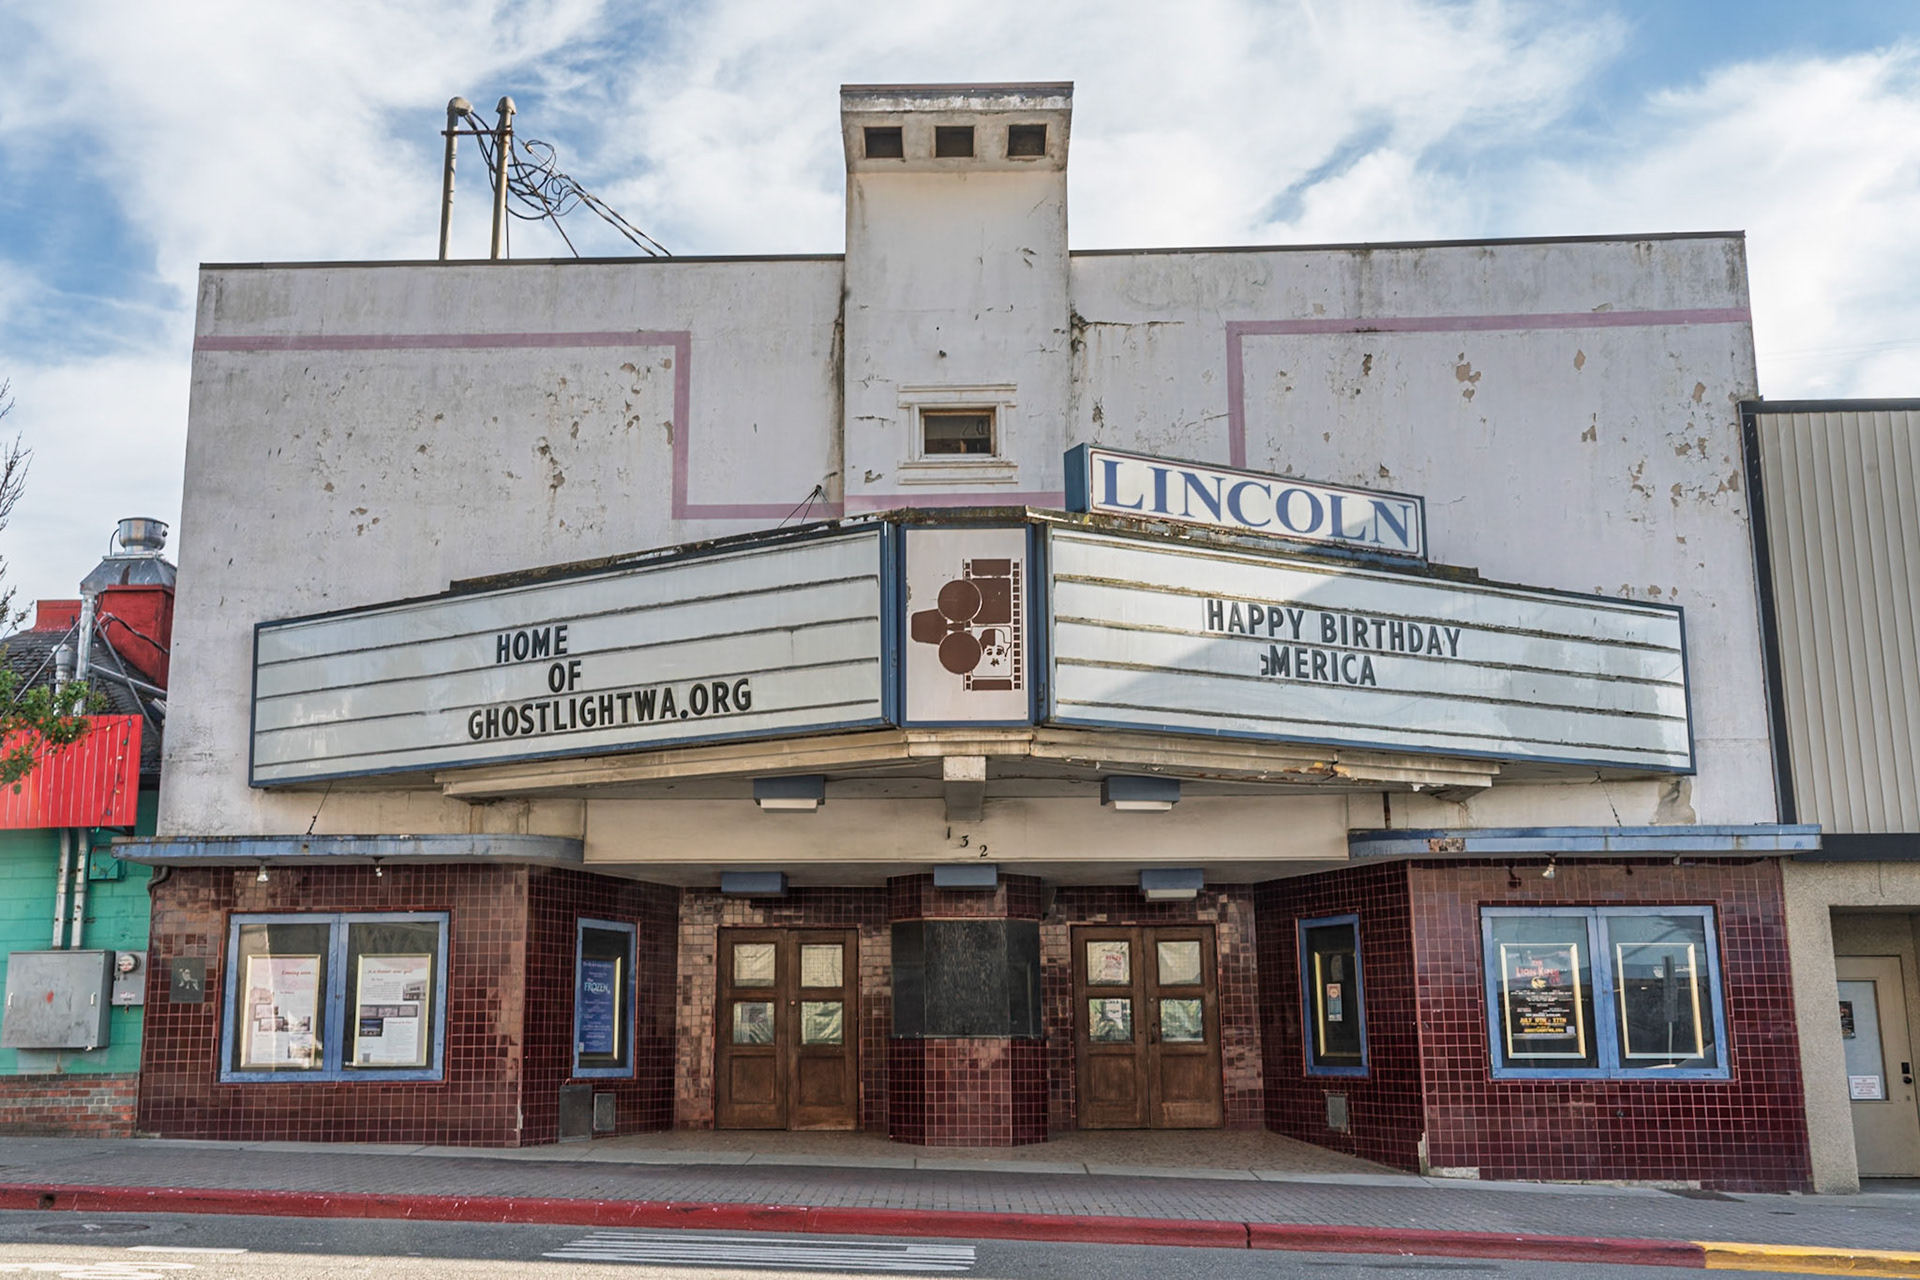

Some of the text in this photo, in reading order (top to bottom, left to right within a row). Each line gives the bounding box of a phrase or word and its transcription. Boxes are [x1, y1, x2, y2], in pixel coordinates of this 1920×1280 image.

[1098, 458, 1410, 548] LINCOLN
[496, 625, 568, 665] HOME
[1207, 599, 1462, 658] HAPPY BIRTHDAY
[548, 661, 582, 693] OF
[467, 678, 752, 741] GHOSTLIGHTWA.ORG
